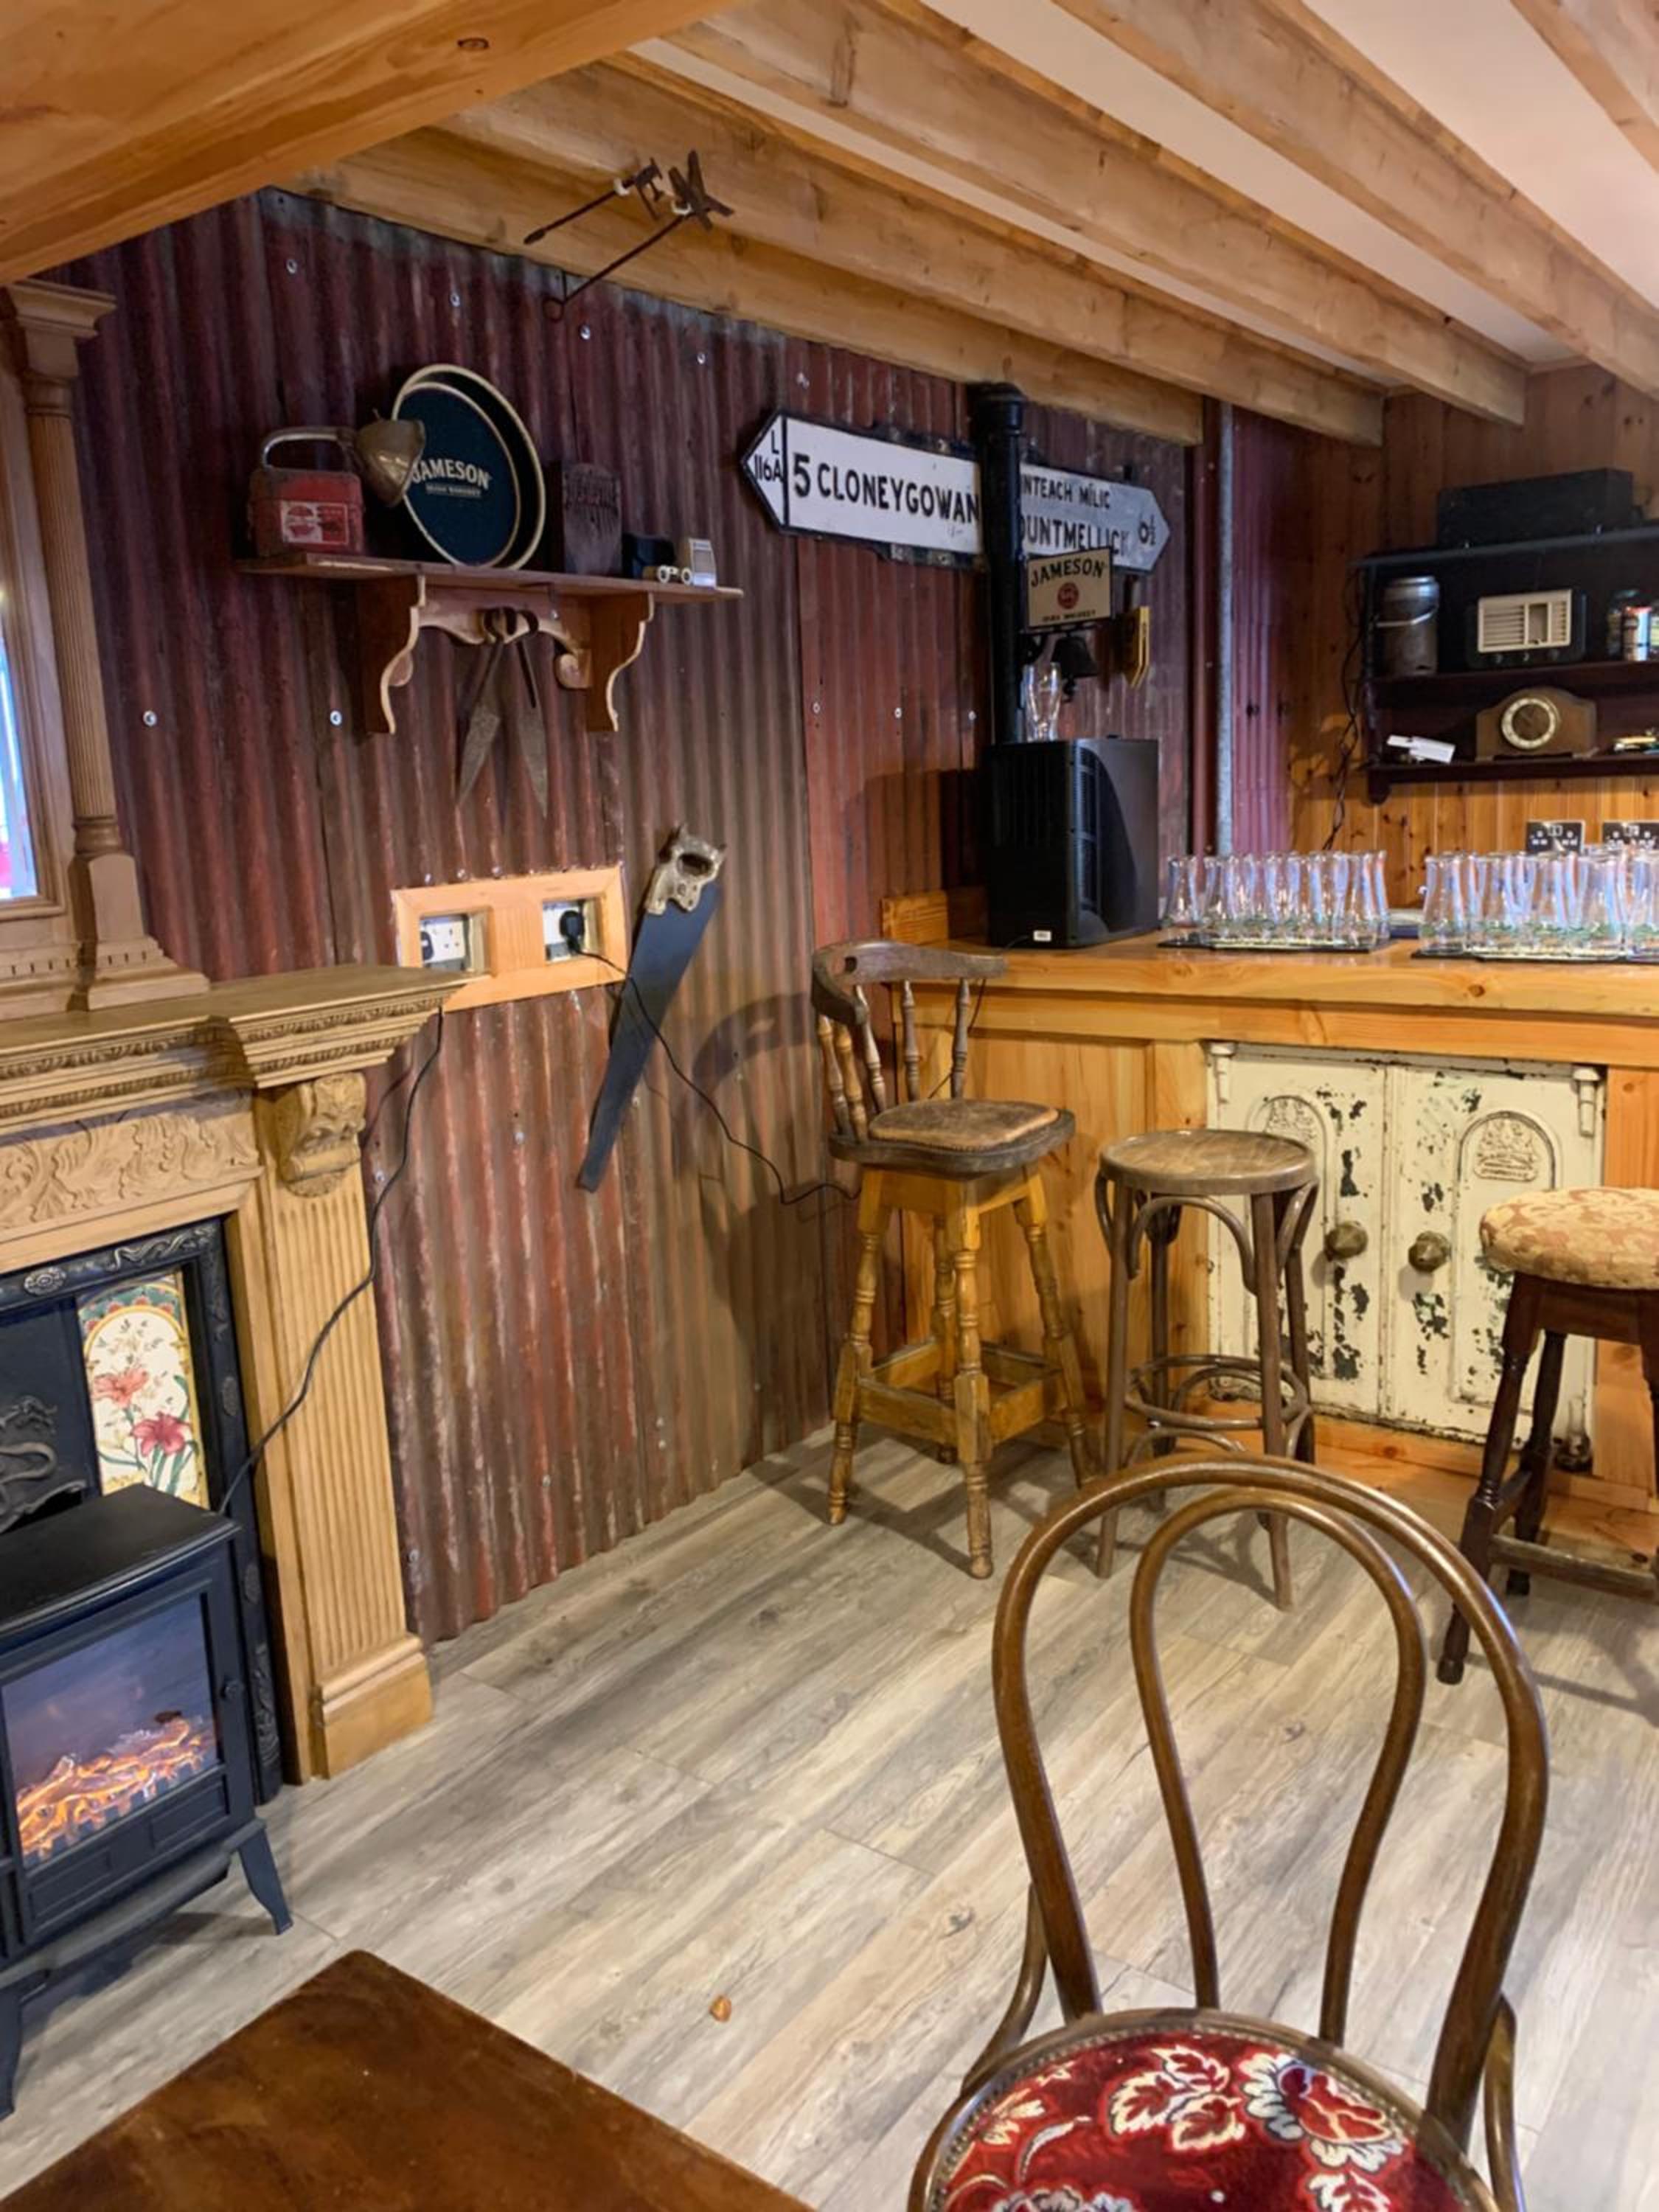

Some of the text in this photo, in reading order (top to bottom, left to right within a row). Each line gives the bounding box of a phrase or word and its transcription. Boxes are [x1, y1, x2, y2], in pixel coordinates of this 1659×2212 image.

[771, 430, 780, 455] L
[411, 458, 490, 490] JAMESON
[754, 453, 783, 482] 116A
[793, 452, 980, 524] 5 CLONEYGOWAN
[1031, 558, 1103, 588] JAMESON
